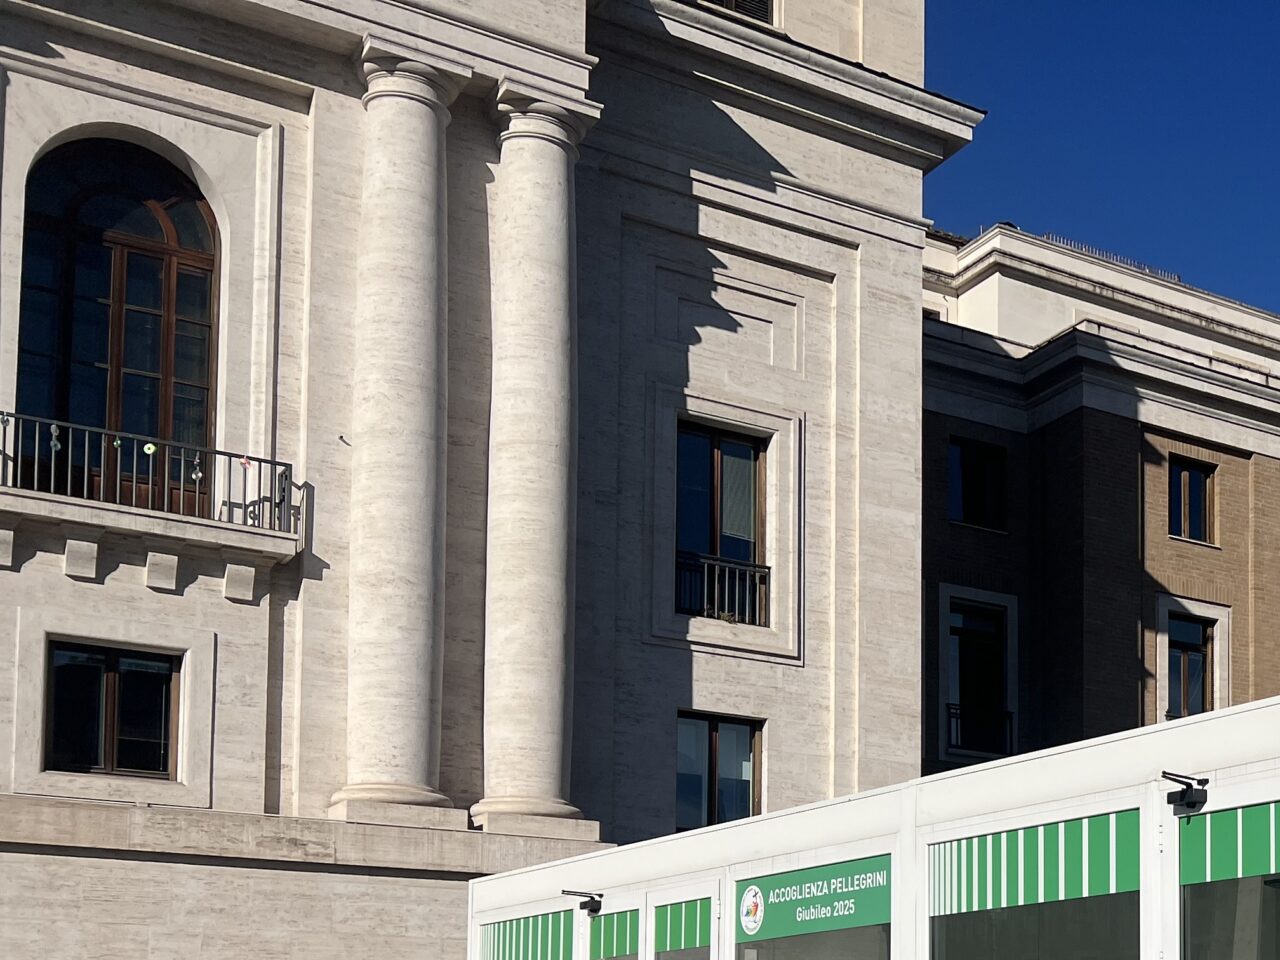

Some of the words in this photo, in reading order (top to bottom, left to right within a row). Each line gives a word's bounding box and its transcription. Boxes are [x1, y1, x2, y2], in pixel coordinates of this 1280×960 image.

[768, 880, 829, 905] ACCOGLIENZA
[830, 870, 887, 894] PELLEGRINI
[796, 904, 832, 922] Giubileo
[833, 899, 855, 917] 2025
